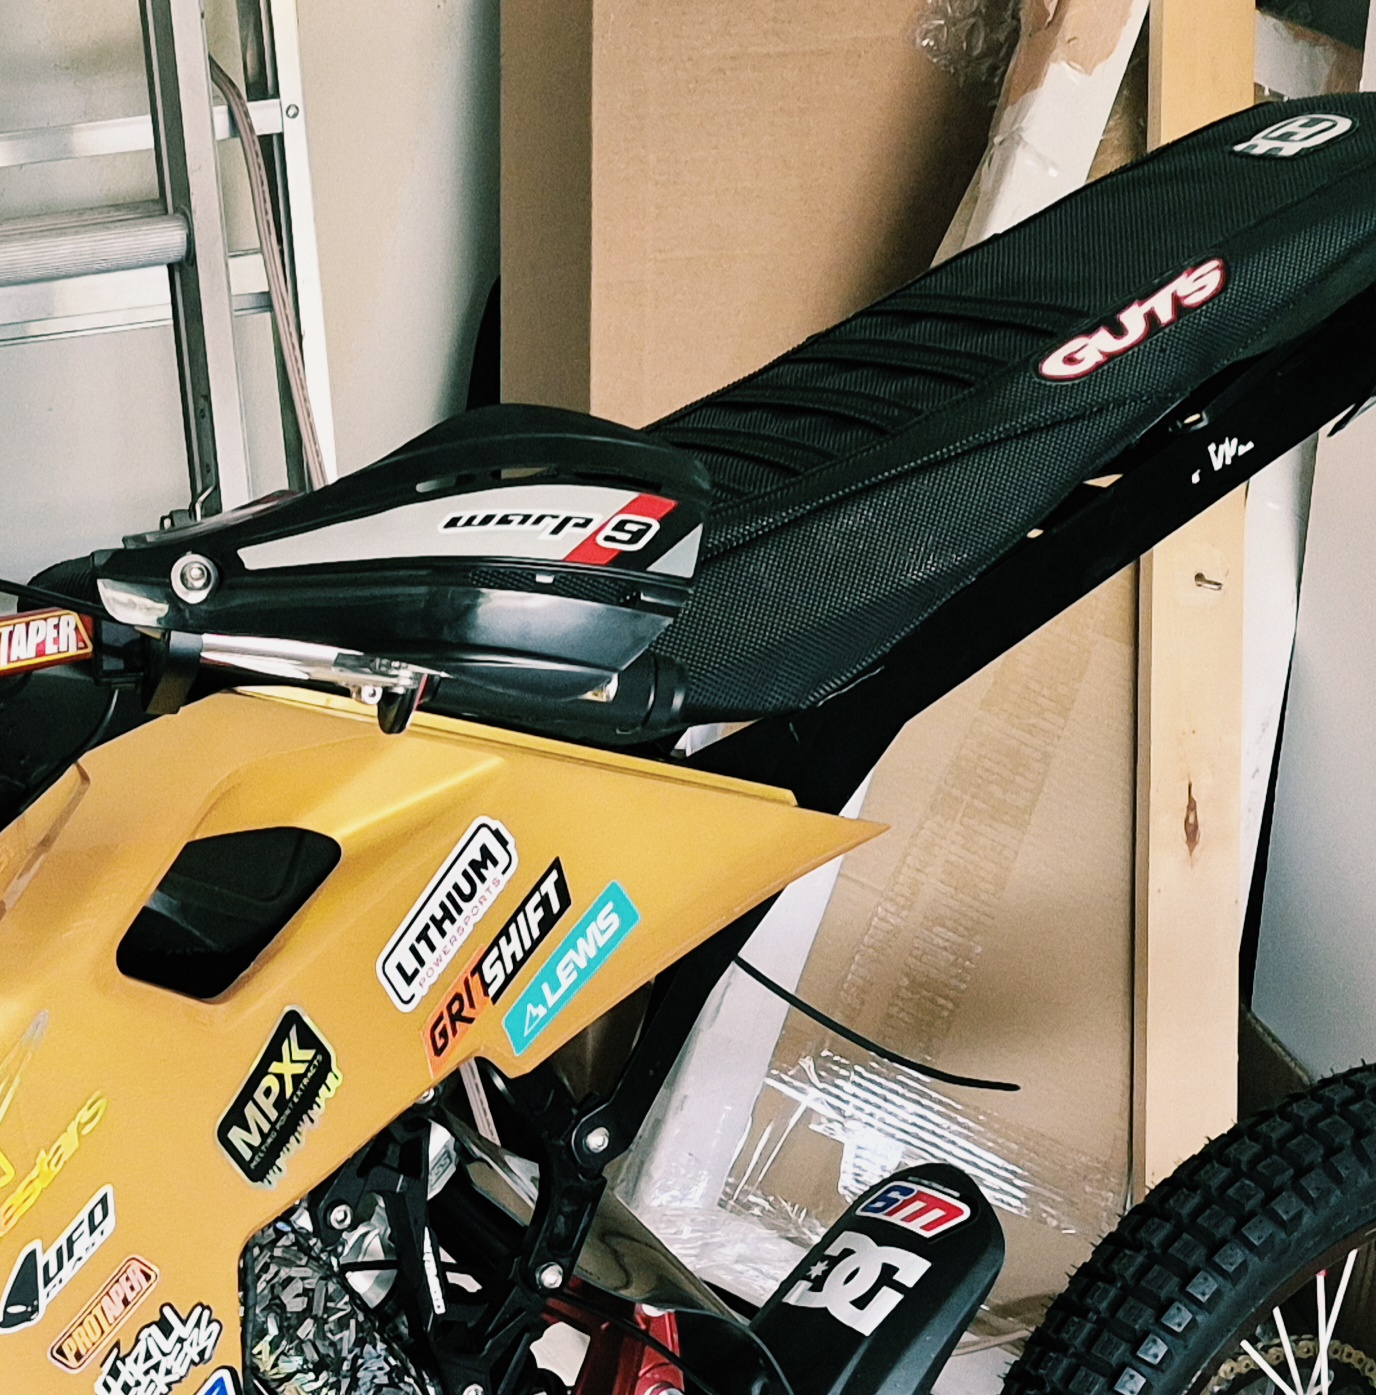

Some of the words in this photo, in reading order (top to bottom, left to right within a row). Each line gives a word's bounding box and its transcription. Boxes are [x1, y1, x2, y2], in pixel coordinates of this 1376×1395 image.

[1039, 258, 1224, 379] GUTS
[395, 843, 500, 988] LITHIUM
[418, 877, 502, 989] POWERSPORTS
[428, 868, 563, 1058] GRITSHIFT
[292, 1054, 323, 1104] EXTRACTS
[42, 1192, 109, 1290] UFO
[60, 1262, 151, 1364] PROTAPER
